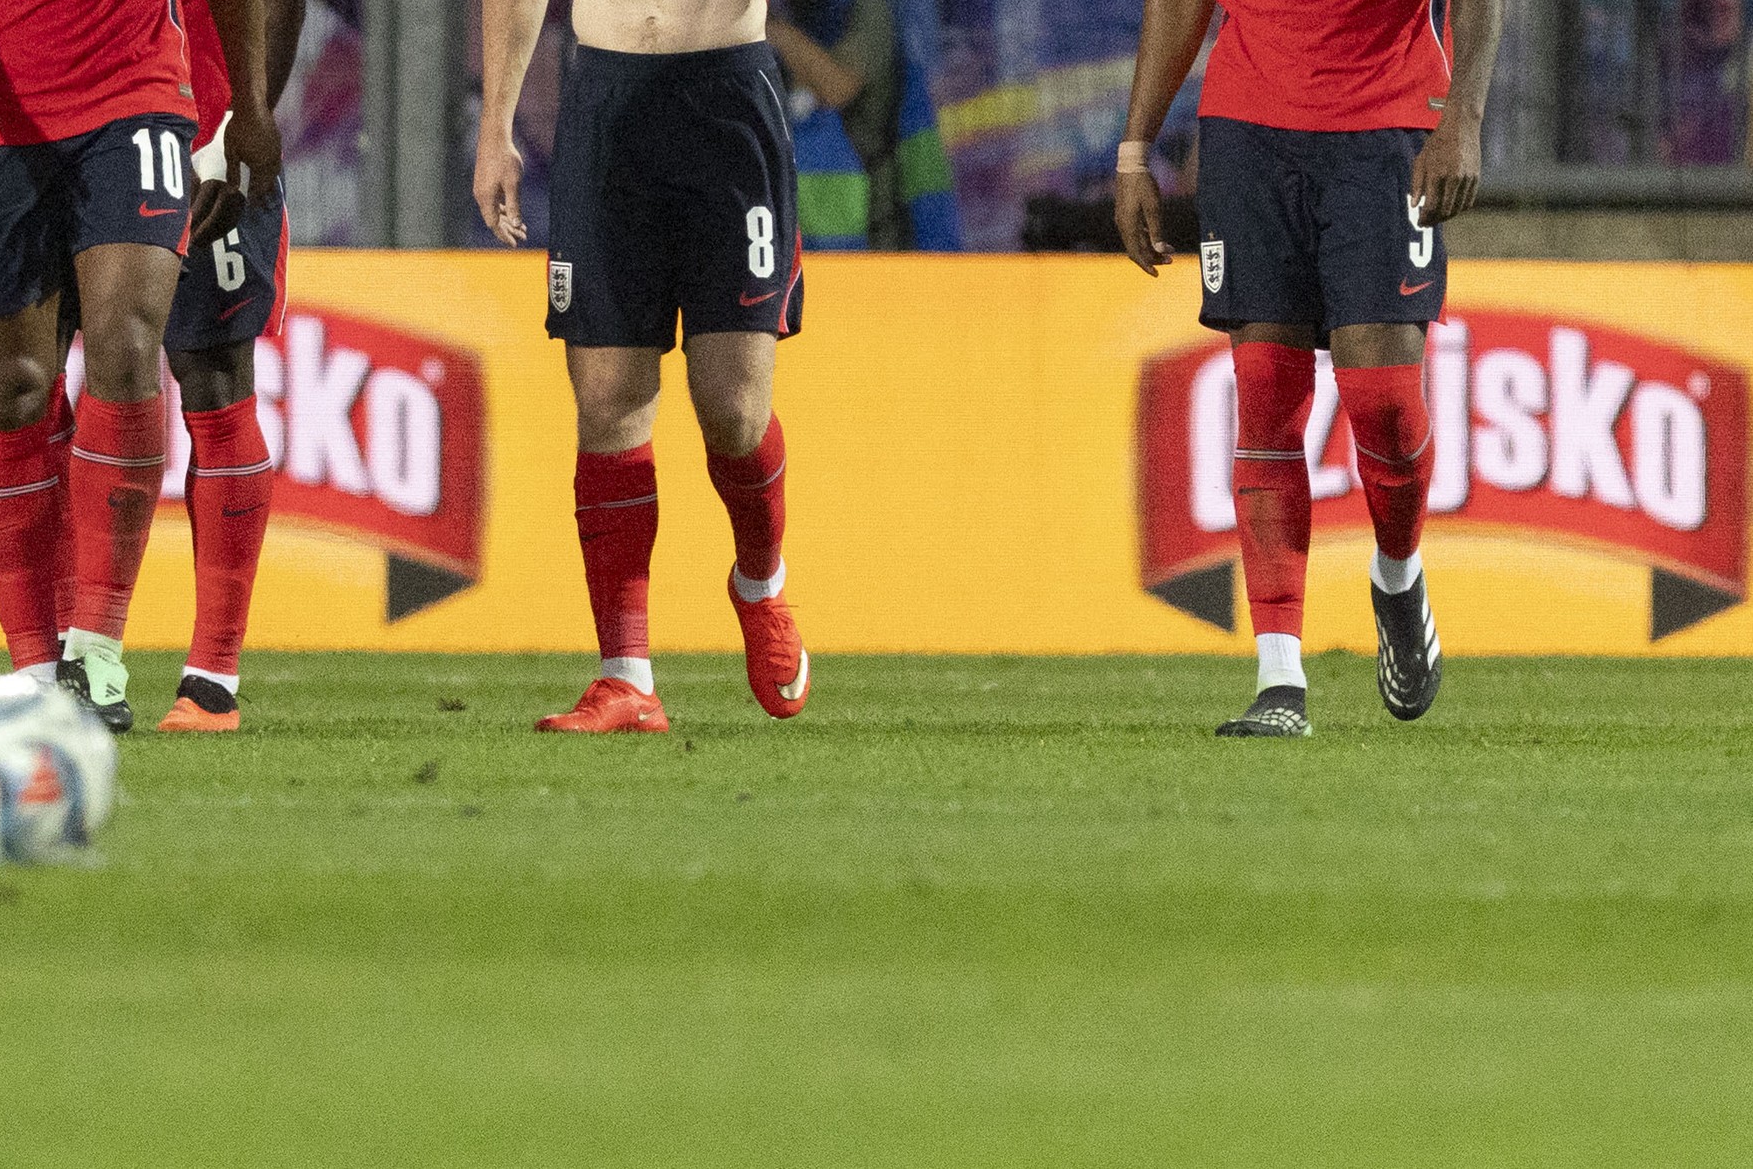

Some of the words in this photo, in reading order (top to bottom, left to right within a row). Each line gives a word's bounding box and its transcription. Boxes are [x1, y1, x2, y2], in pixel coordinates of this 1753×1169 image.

[132, 128, 184, 199] 10
[212, 227, 246, 292] 6
[746, 206, 774, 278] 8
[1407, 194, 1434, 268] 5
[1189, 318, 1708, 532] Ojsko
